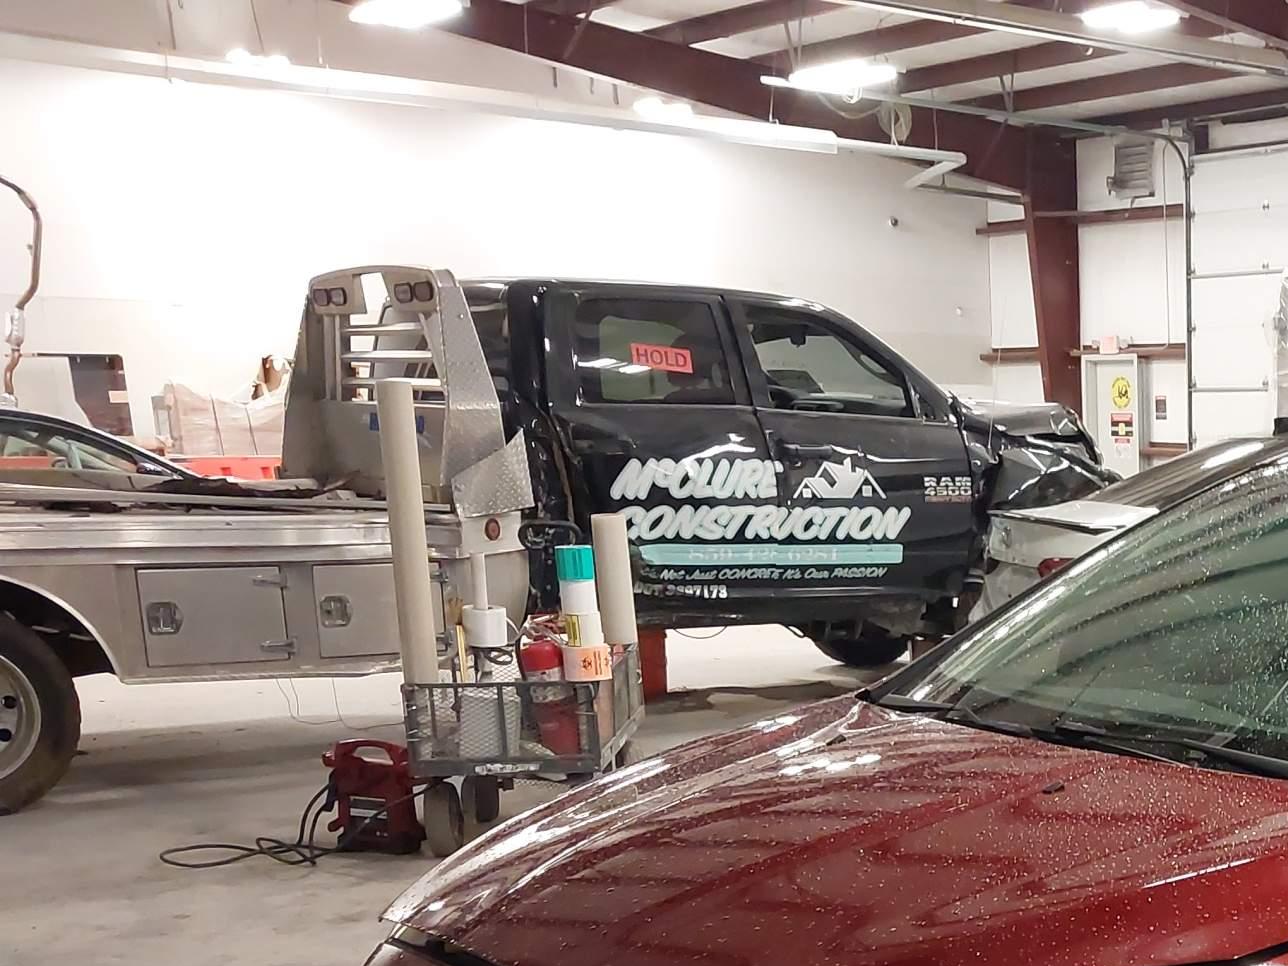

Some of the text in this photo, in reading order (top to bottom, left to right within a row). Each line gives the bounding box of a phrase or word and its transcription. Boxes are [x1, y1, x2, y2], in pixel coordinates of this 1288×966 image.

[635, 347, 687, 368] HOLD
[923, 476, 972, 487] RAM
[924, 486, 972, 496] 4500
[621, 504, 911, 541] CONSTRUCTION
[660, 568, 685, 580] Not
[830, 566, 888, 579] PASSION
